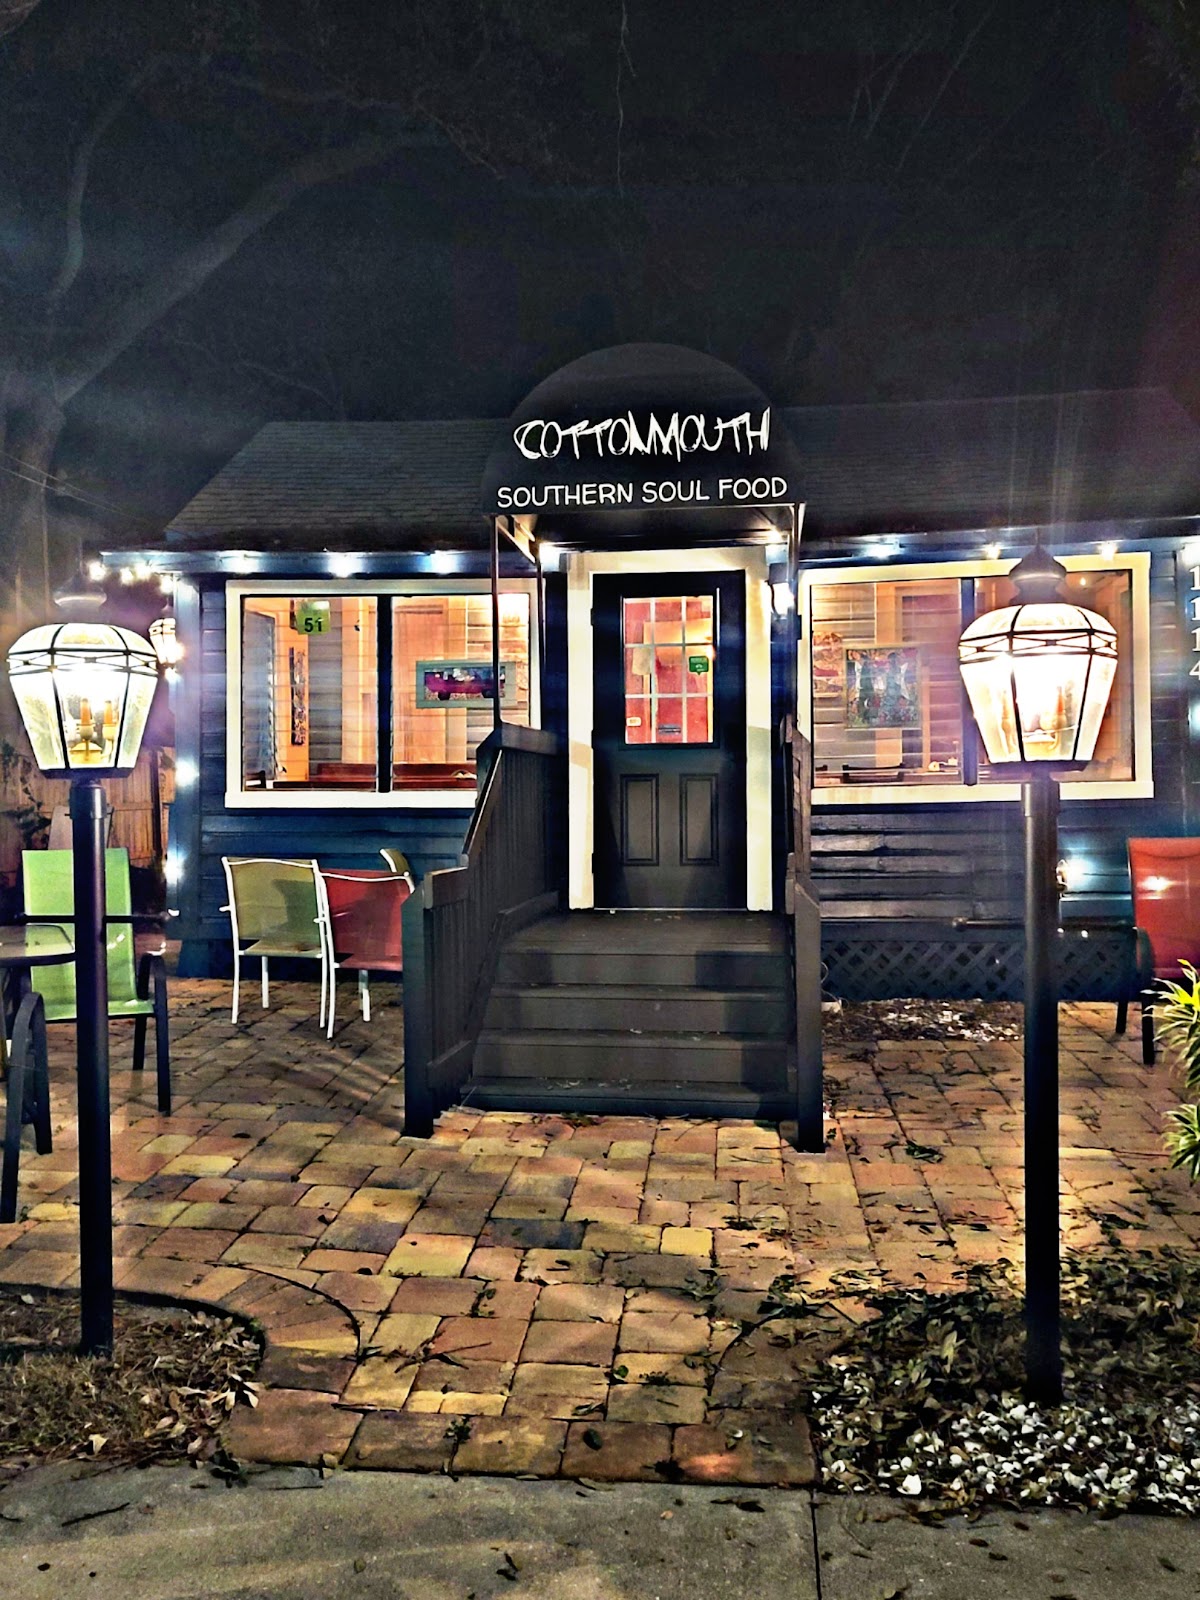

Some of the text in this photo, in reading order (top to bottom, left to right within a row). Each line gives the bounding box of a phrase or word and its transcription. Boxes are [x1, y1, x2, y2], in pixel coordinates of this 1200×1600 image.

[513, 407, 771, 462] COTTONMOUTH
[496, 477, 788, 508] SOUTHERN SOUL FOOD
